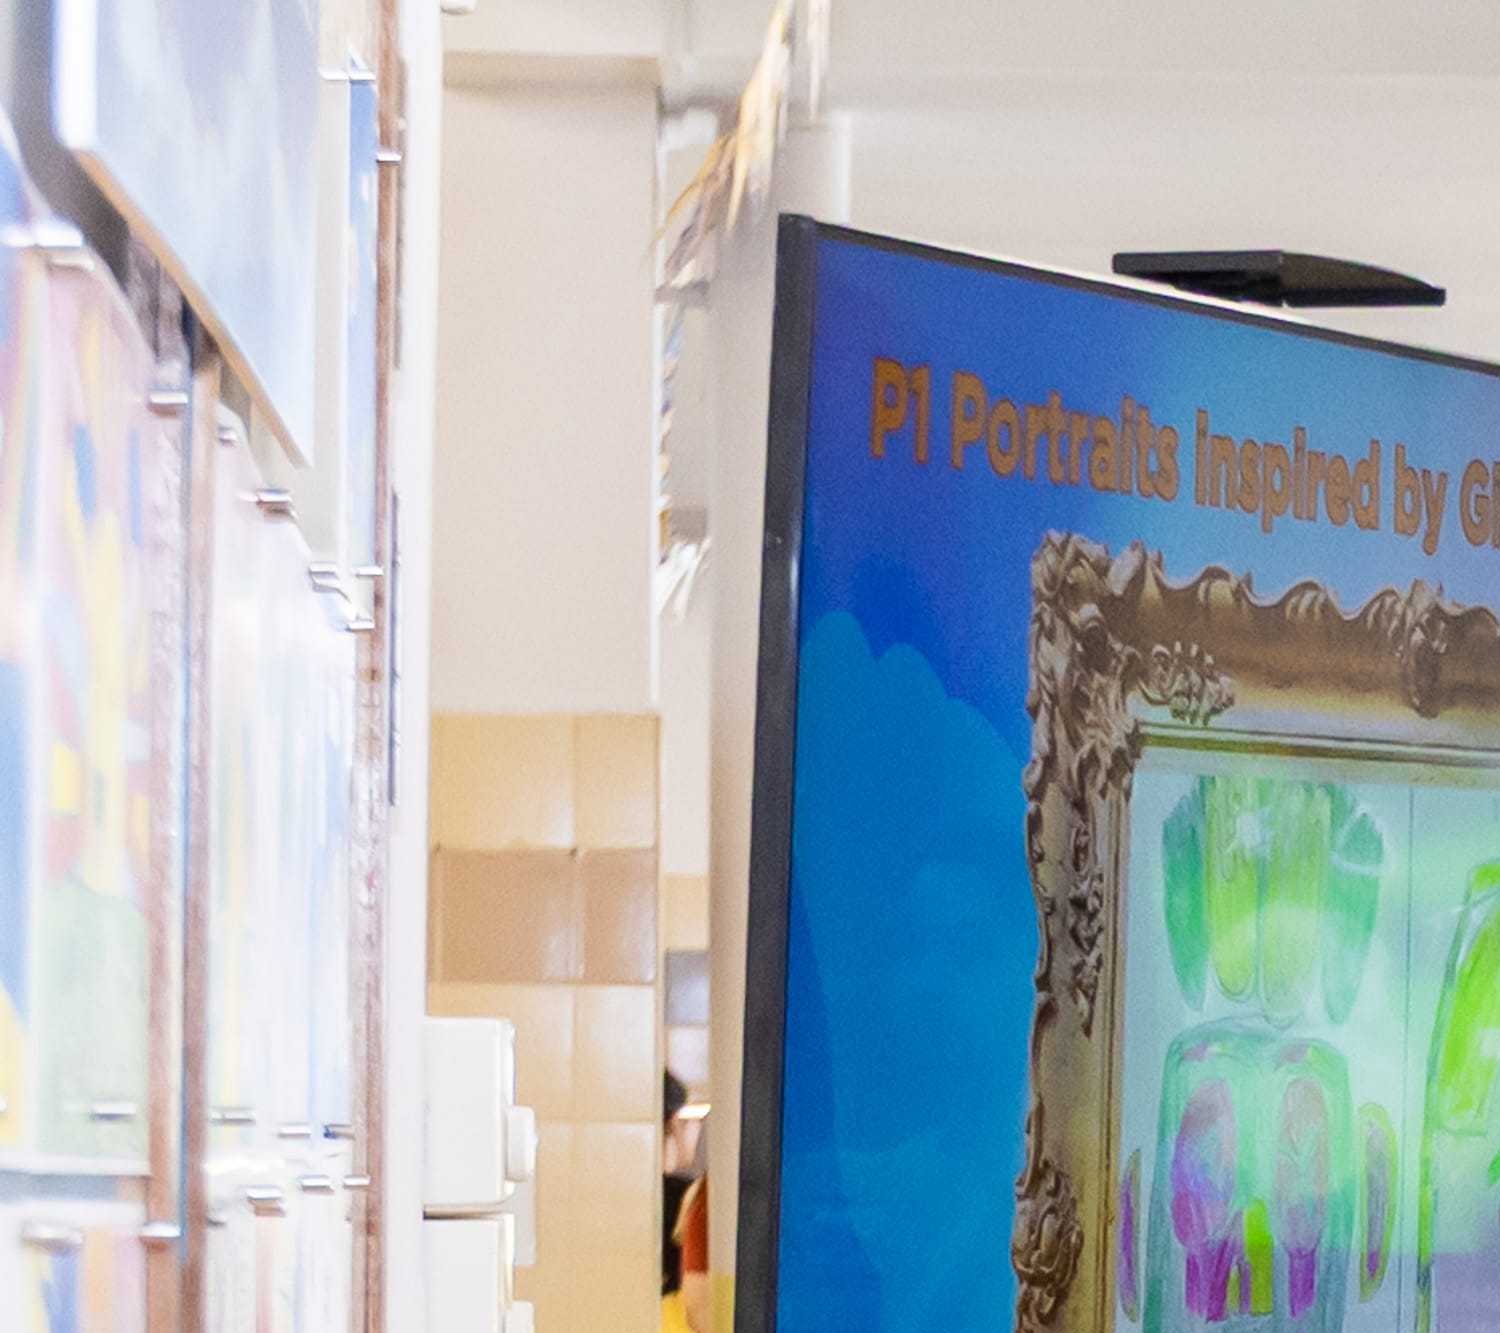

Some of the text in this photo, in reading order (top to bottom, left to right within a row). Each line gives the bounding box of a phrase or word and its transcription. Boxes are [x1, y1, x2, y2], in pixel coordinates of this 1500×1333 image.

[870, 355, 931, 465] P1
[950, 370, 1180, 502] Portraits
[1394, 439, 1449, 556] by
